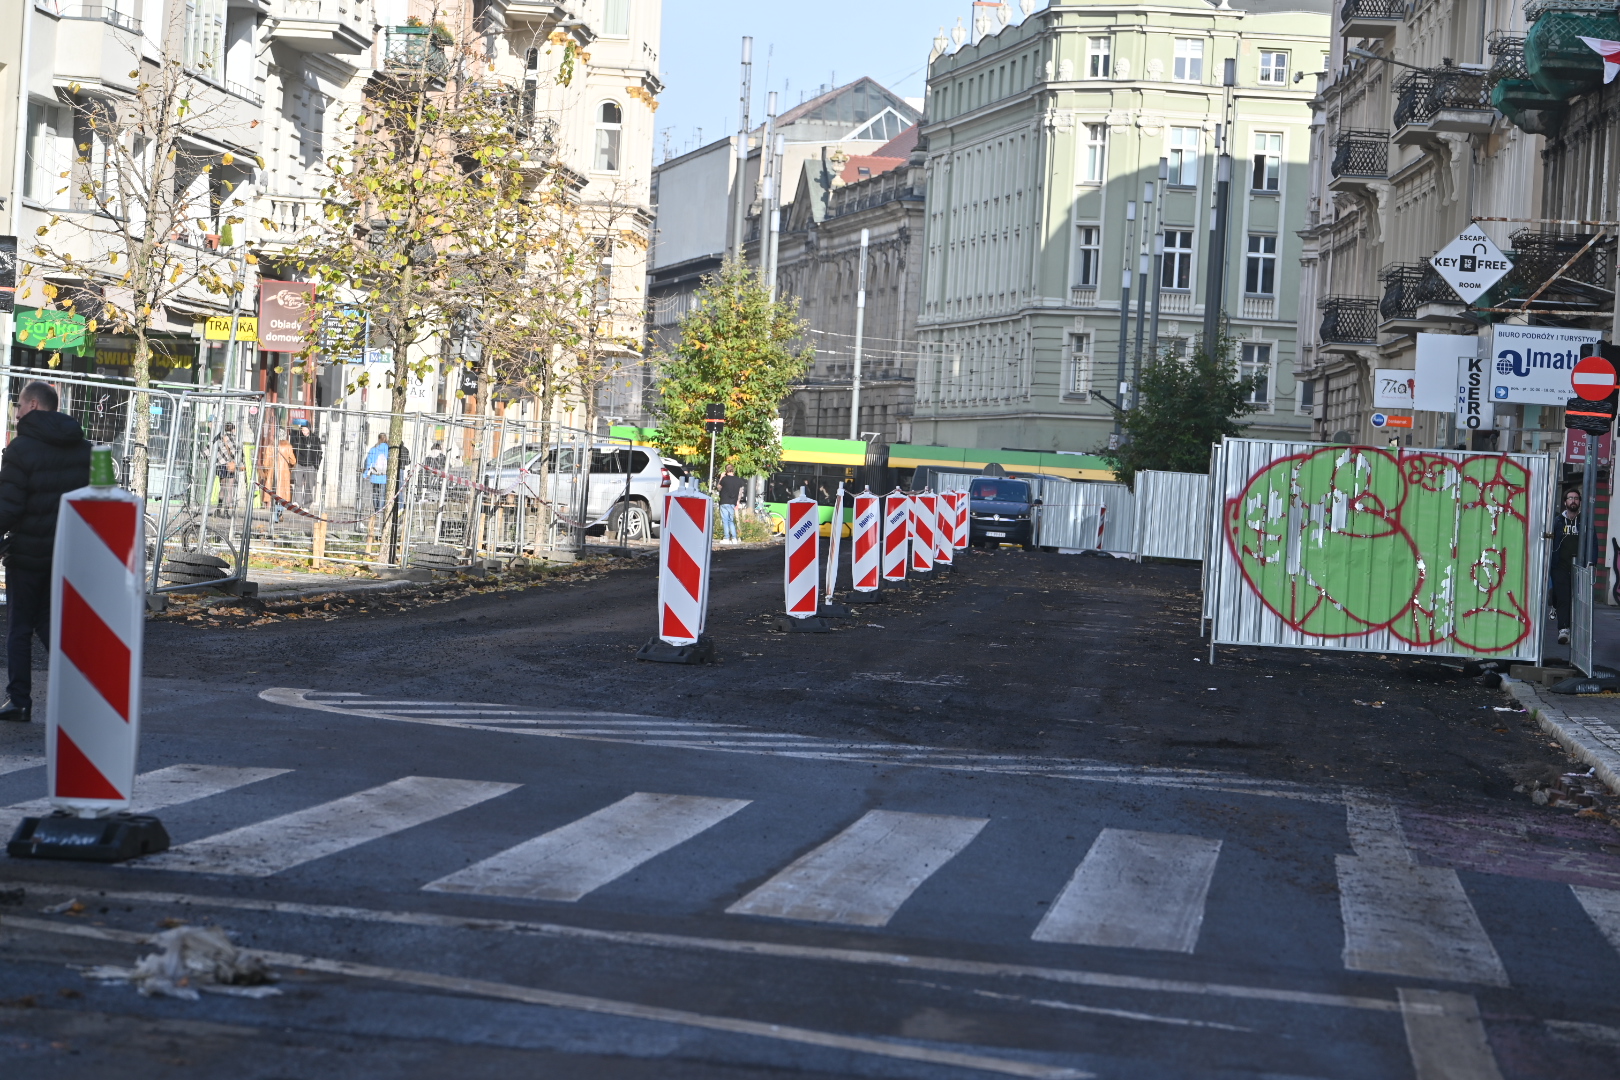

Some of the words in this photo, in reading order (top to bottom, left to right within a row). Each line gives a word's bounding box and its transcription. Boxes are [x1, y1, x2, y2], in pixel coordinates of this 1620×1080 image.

[1434, 257, 1458, 267] KEY
[1478, 260, 1507, 270] FREE
[1498, 331, 1520, 339] BIURO
[1521, 332, 1555, 341] PODRÓŻY
[1560, 334, 1597, 343] TURYSTYKI
[1467, 359, 1483, 429] KSERO
[858, 512, 875, 529] DROMO
[889, 510, 905, 525] DROMO
[793, 520, 813, 540] DROMO
